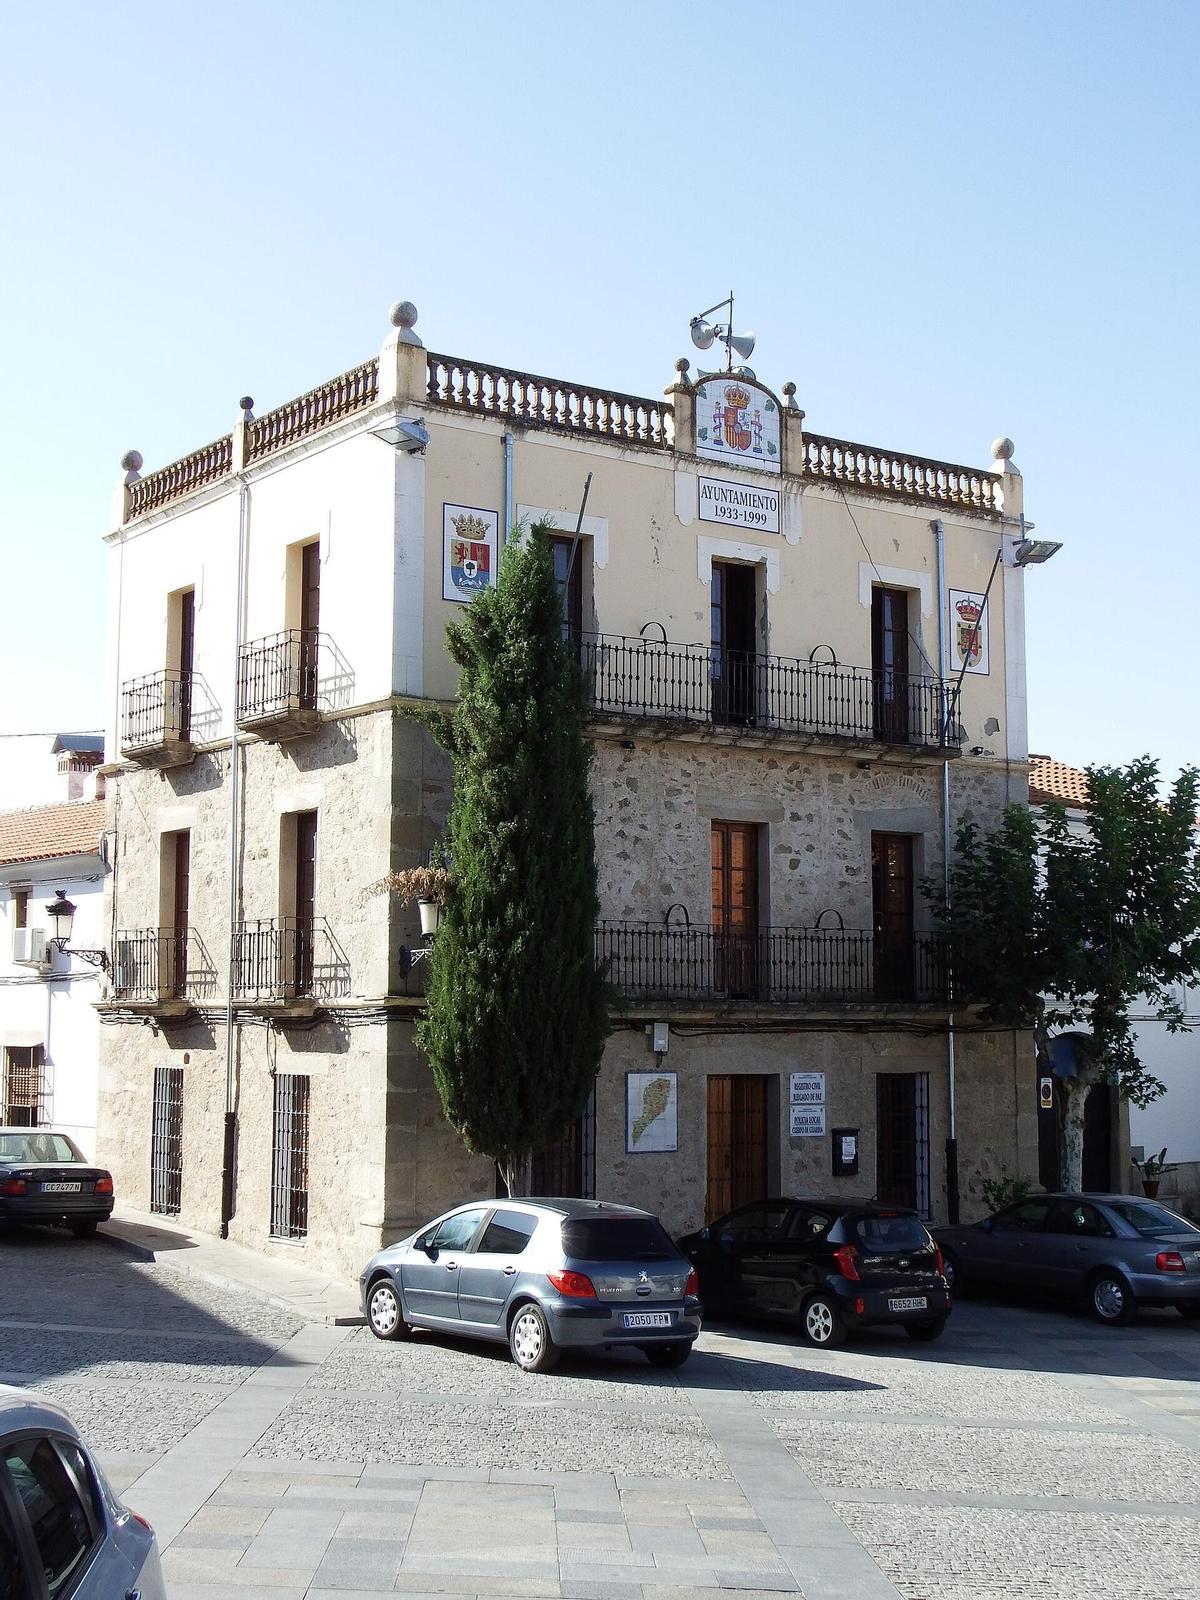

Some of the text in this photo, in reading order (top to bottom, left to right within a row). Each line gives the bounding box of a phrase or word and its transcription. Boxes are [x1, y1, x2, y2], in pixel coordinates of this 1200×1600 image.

[701, 484, 778, 512] AYUNTAMIENTO
[714, 505, 767, 525] 1.933-1.999
[811, 1082, 821, 1090] CIVIL
[630, 1315, 651, 1325] 2050
